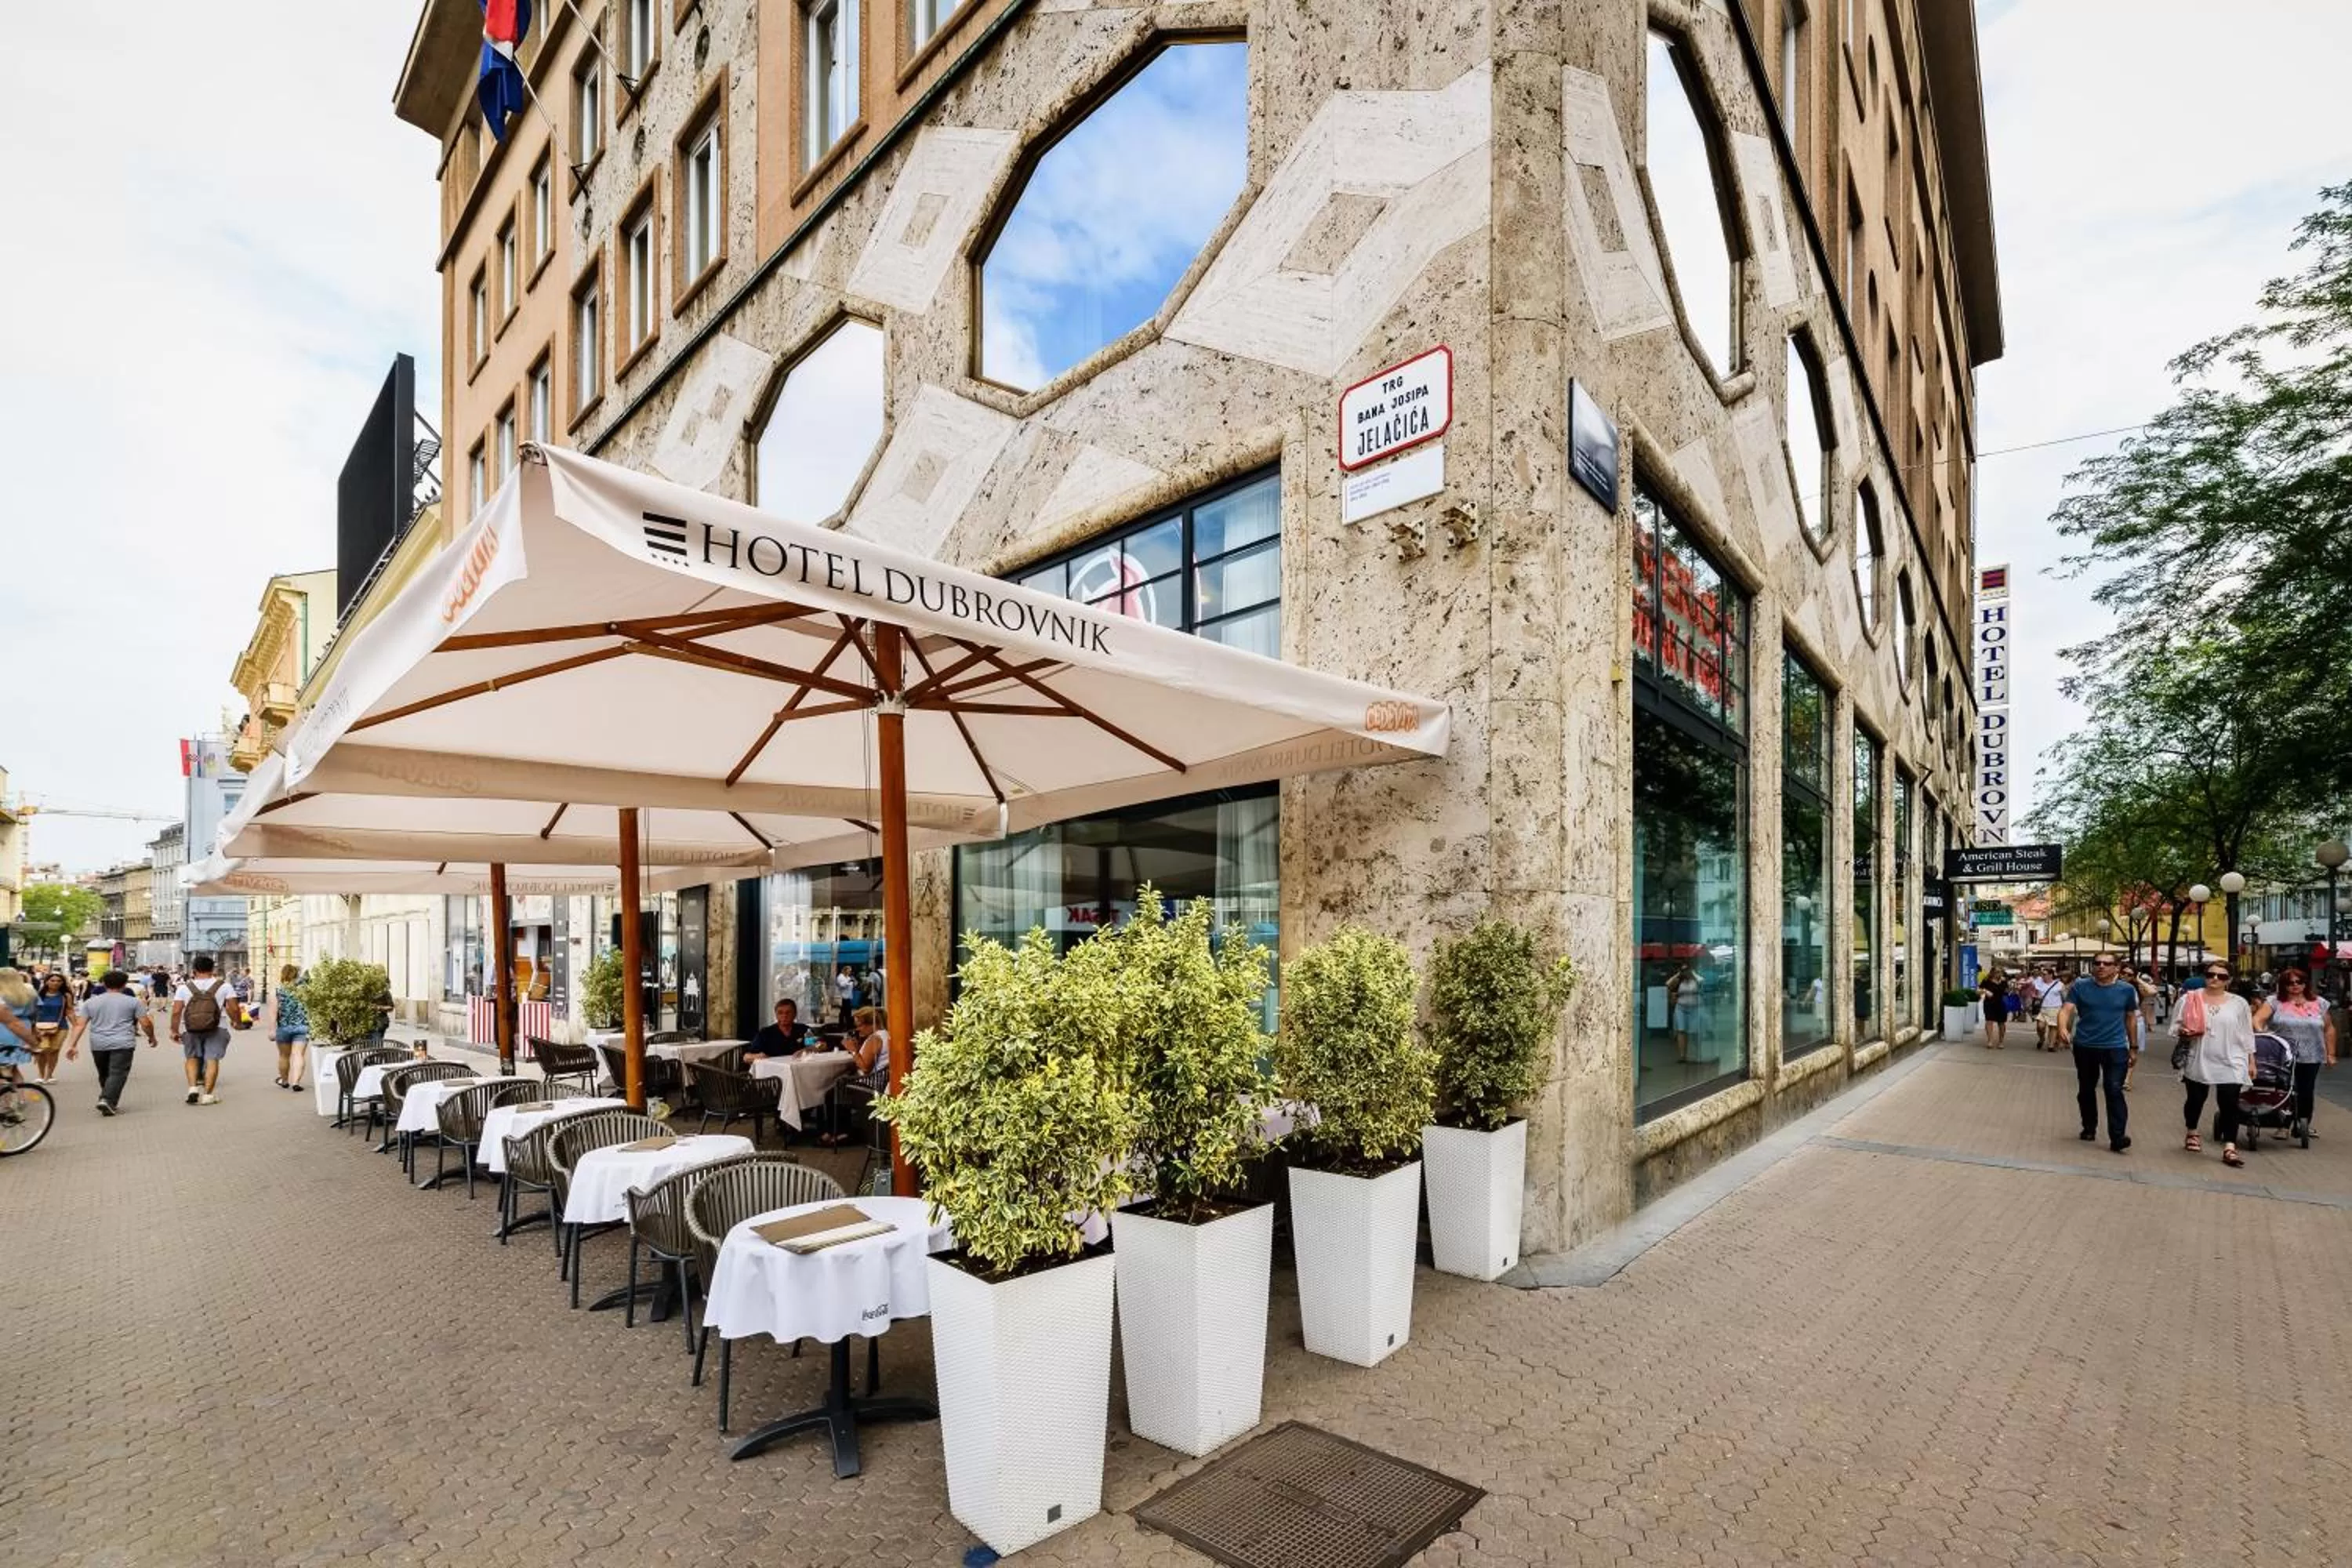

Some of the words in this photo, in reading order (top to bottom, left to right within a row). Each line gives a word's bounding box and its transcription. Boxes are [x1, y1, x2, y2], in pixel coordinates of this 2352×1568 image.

[1357, 402, 1385, 424] BANA
[1391, 384, 1429, 409] JOSIPA
[1382, 376, 1403, 394] TRG
[1357, 405, 1429, 456] JELAČIĆA
[700, 522, 873, 597] HOTEL
[884, 567, 1112, 655] DUBROVNIK
[1980, 606, 2006, 702] HOTEL
[1958, 849, 2013, 862] American
[2015, 848, 2048, 859] Steak
[1962, 862, 1973, 873] &
[1976, 862, 2003, 873] Grill
[2005, 861, 2042, 872] House
